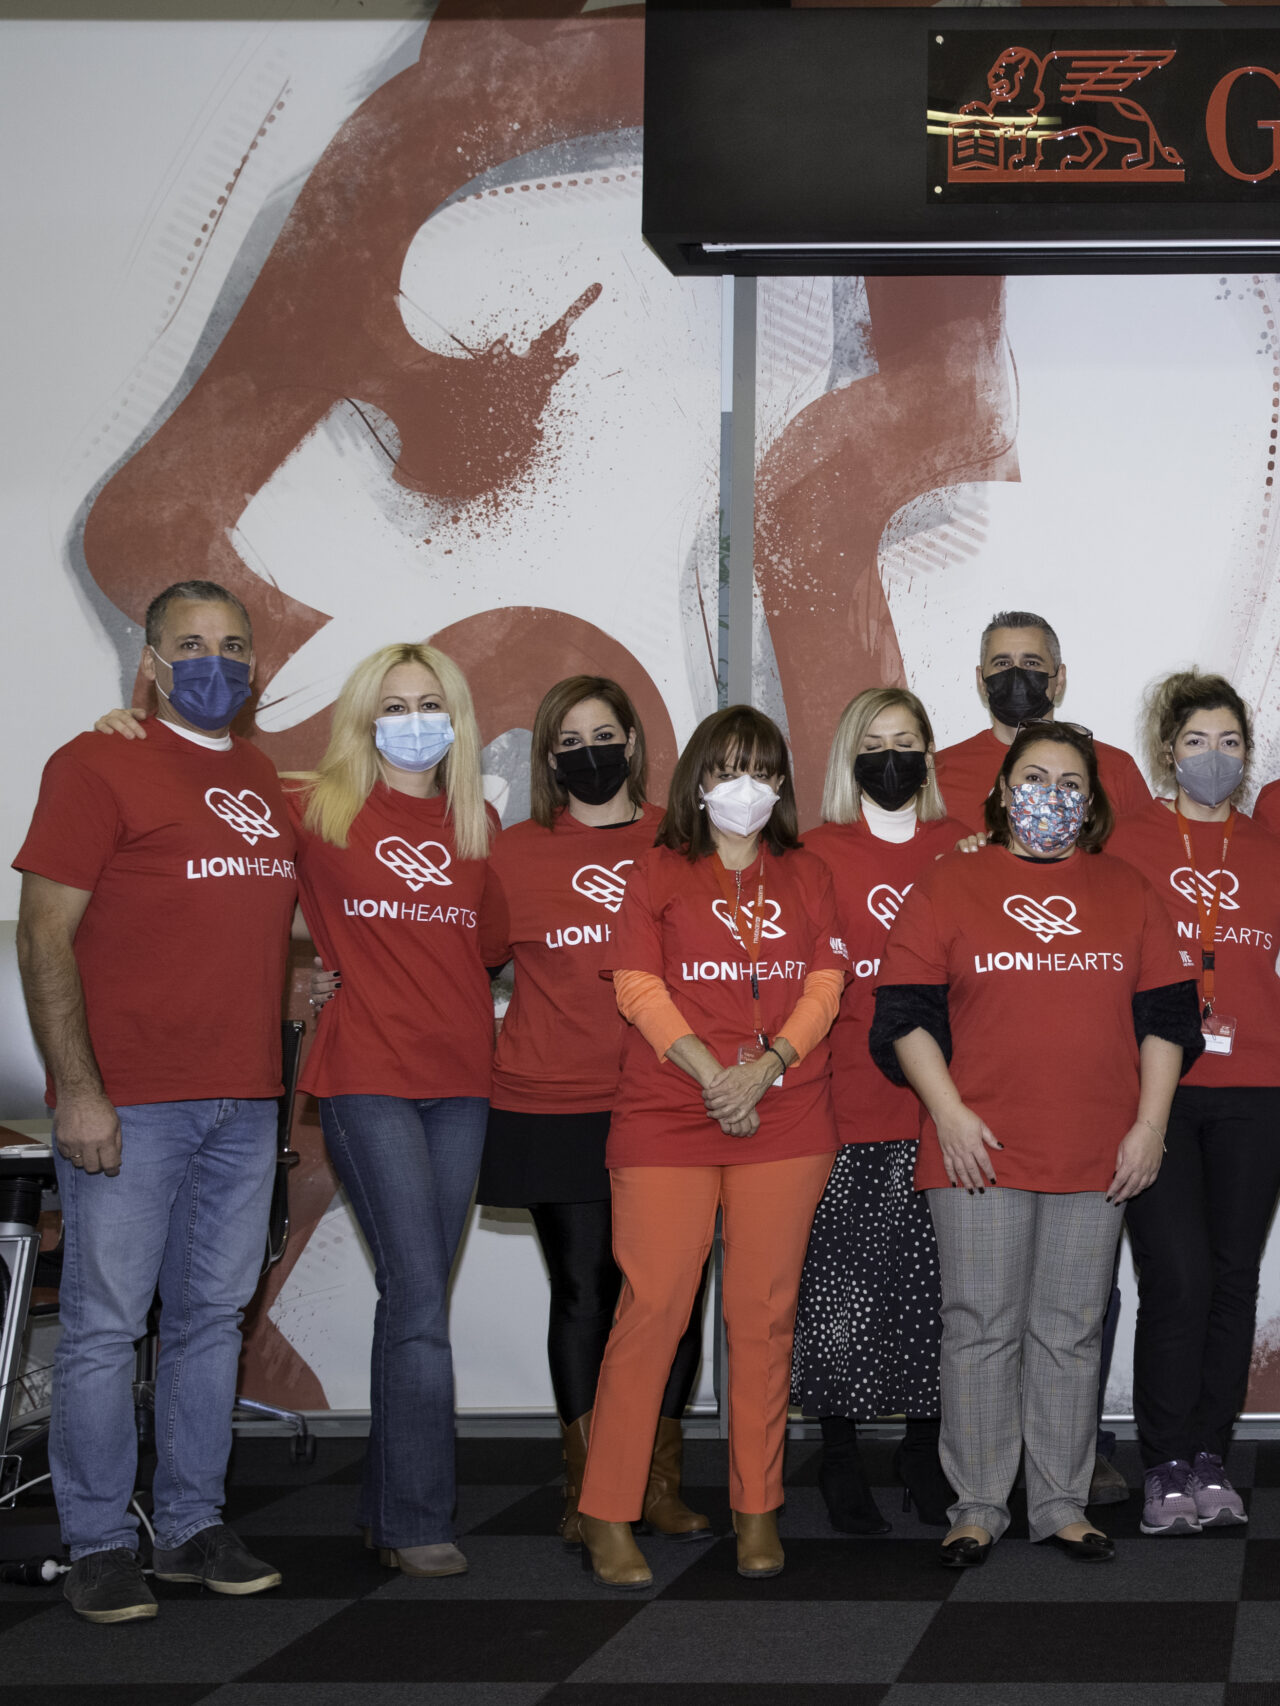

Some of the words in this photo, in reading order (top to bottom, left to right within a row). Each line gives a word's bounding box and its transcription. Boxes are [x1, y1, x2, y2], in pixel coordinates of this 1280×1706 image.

[187, 857, 297, 880] LIONHEART
[343, 898, 477, 928] LIONHEARTS
[681, 960, 806, 981] LIONHEART
[974, 951, 1124, 973] LIONHEARTS
